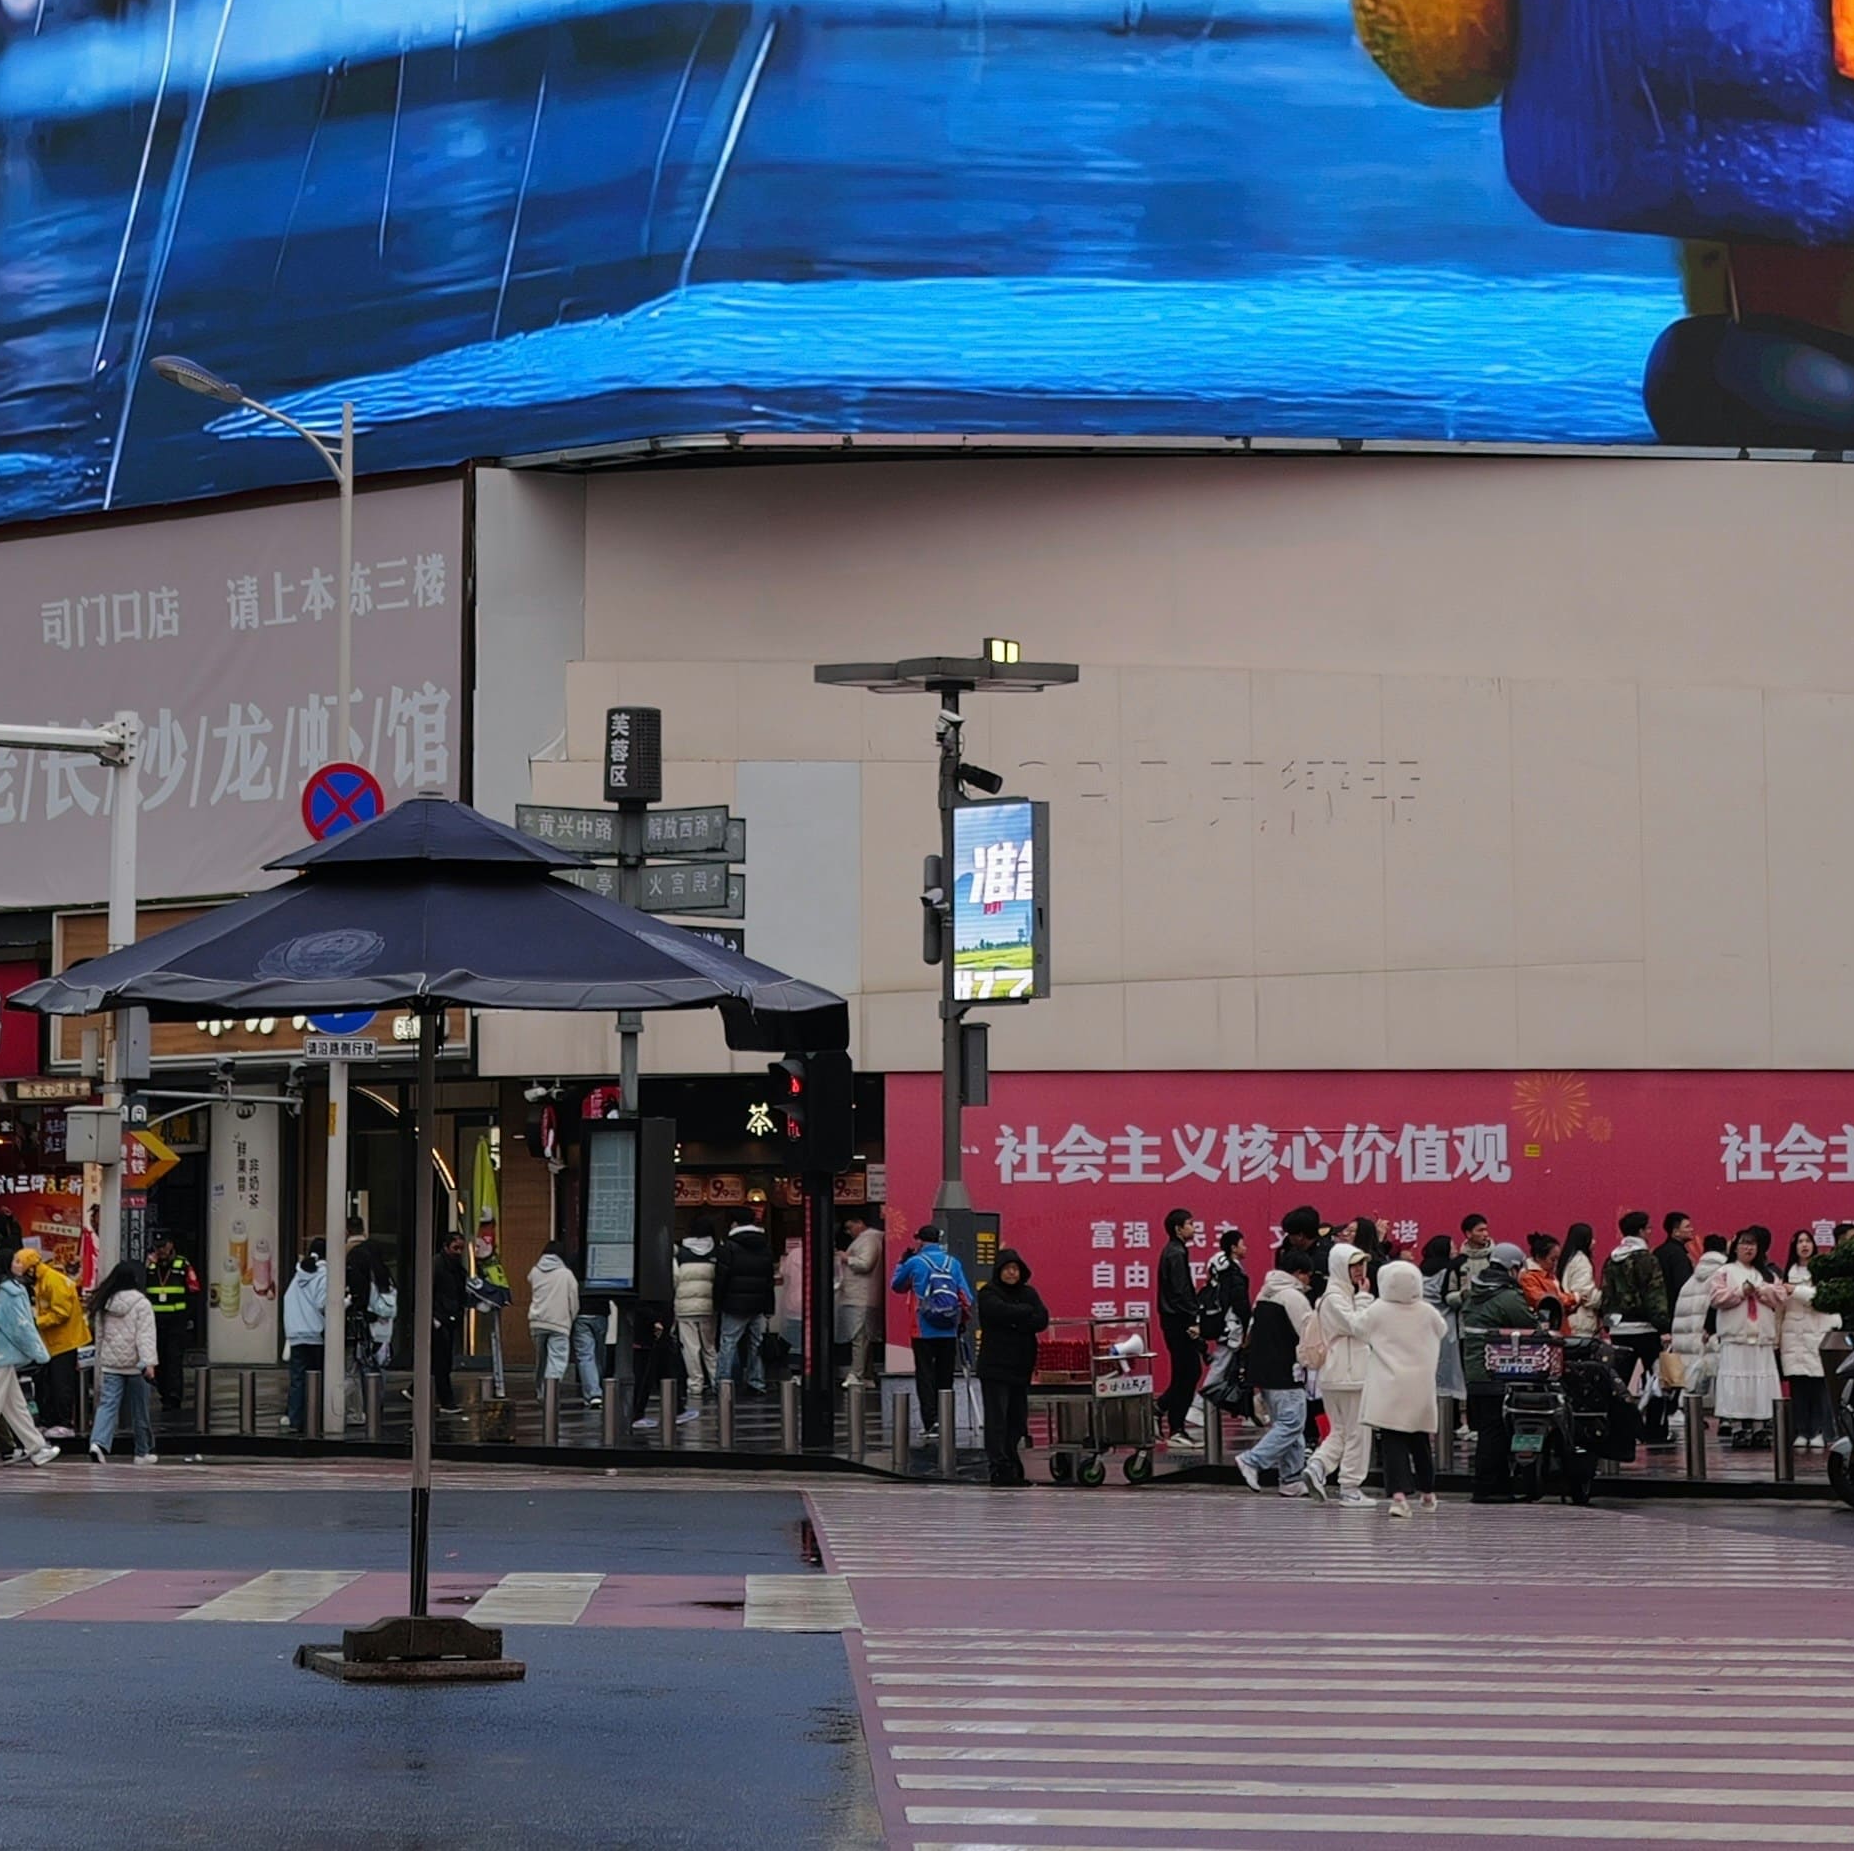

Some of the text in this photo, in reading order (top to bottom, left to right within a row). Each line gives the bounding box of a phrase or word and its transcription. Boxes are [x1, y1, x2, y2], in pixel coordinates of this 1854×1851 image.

[41, 586, 180, 650] 司门口店
[609, 712, 631, 788] 芙蓉区
[538, 814, 613, 842] 黄兴中路
[647, 815, 709, 840] 解放西路
[305, 1040, 375, 1057] 请沿路侧行驶
[131, 1143, 147, 1175] 地铁
[993, 1122, 1513, 1185] 社会主义核心价值观
[1090, 1220, 1151, 1249] 富强
[1091, 1261, 1150, 1289] 自由
